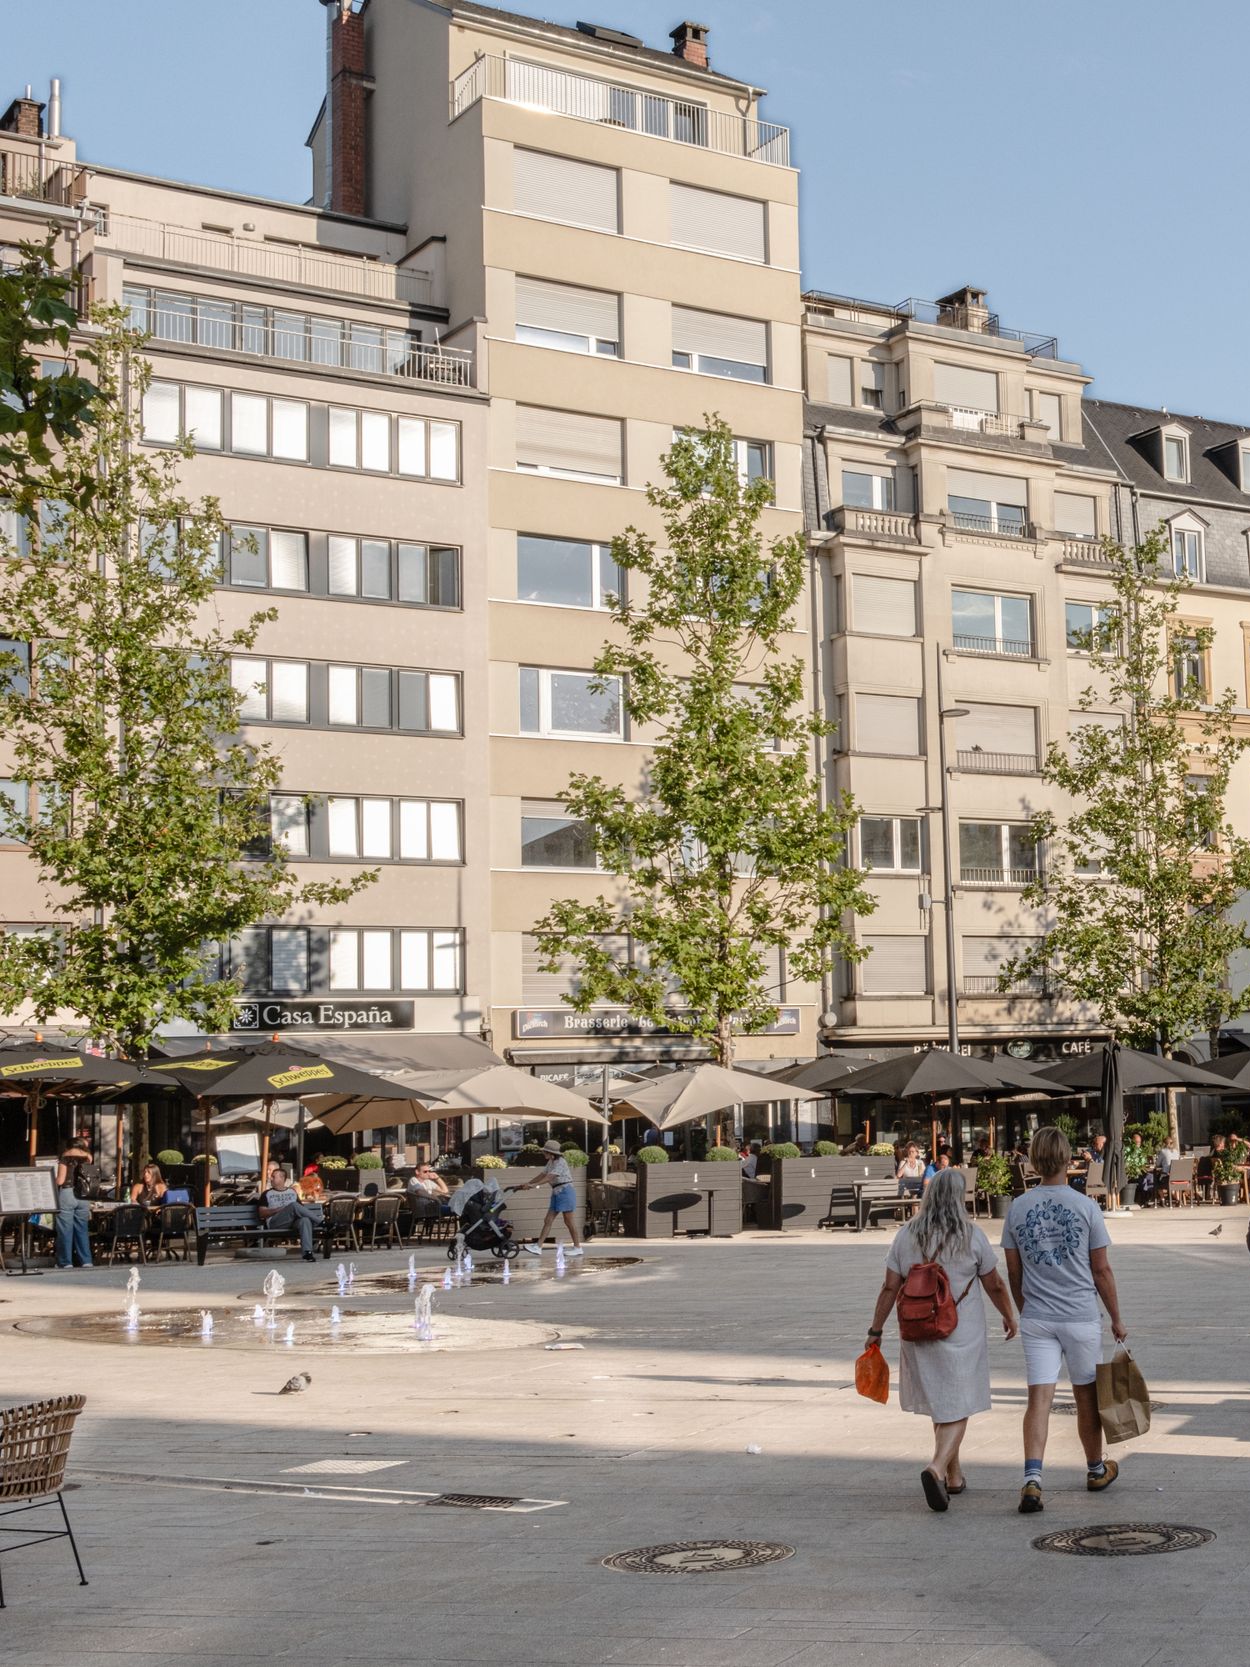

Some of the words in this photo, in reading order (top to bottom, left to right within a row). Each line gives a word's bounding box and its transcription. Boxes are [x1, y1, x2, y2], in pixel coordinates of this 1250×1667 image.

[263, 1005, 314, 1025] Casa
[318, 1004, 393, 1029] España
[563, 1015, 628, 1029] Brasserie
[1062, 1038, 1091, 1053] CAFÉ
[4, 1058, 79, 1074] Schweppes
[271, 1067, 329, 1087] Schweppes
